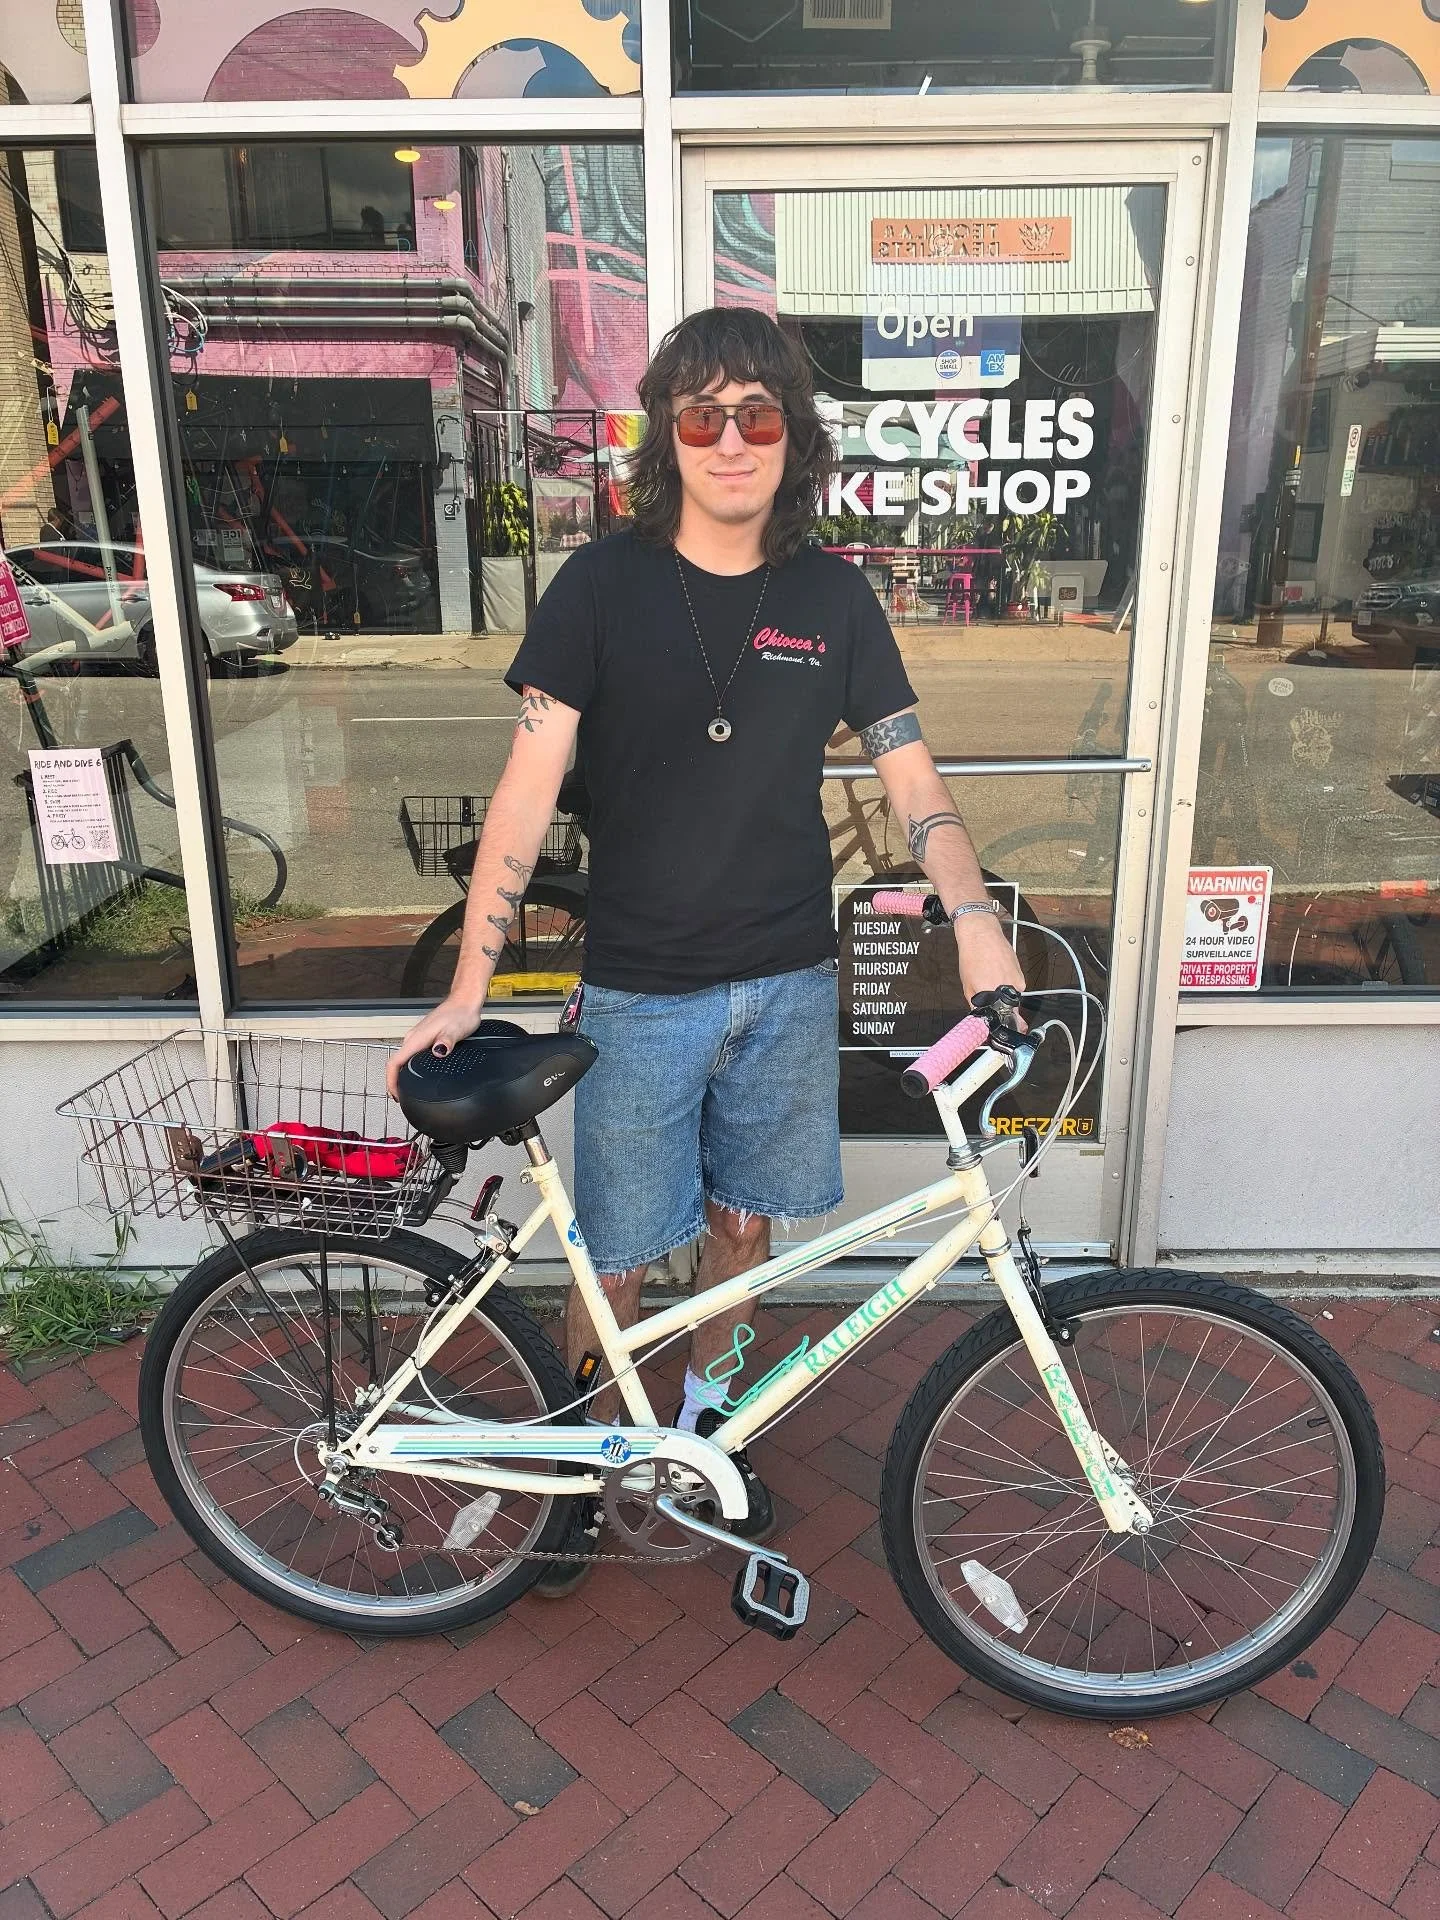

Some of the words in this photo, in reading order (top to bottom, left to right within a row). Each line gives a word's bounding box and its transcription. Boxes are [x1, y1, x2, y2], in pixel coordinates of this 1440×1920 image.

[877, 307, 974, 346] Open
[986, 354, 1004, 362] AM
[921, 469, 1091, 516] SHOP
[753, 627, 826, 654] Chiocca's
[34, 760, 51, 770] RIDE
[53, 759, 73, 770] AND
[74, 759, 94, 768] DIVE
[1189, 876, 1263, 892] WARNING
[853, 922, 901, 935] TUESDAY
[1186, 937, 1197, 946] 24
[1200, 937, 1224, 945] HOUR
[1227, 936, 1255, 945] VIDEO
[853, 942, 920, 955] WEDNESDAY
[1186, 950, 1252, 958] SURVEILLANCE
[853, 962, 909, 975] THURSDAY
[1180, 964, 1212, 974] PRIVATE
[1214, 963, 1256, 974] PROPERTY
[1181, 975, 1192, 985] NO
[1195, 974, 1250, 985] TRESPASSING
[853, 982, 891, 996] FRIDAY
[852, 1002, 907, 1015] SATURDAY
[852, 1021, 895, 1035] SUNDAY
[988, 1117, 1077, 1136] REEZR
[803, 1280, 908, 1376] RALEIGH
